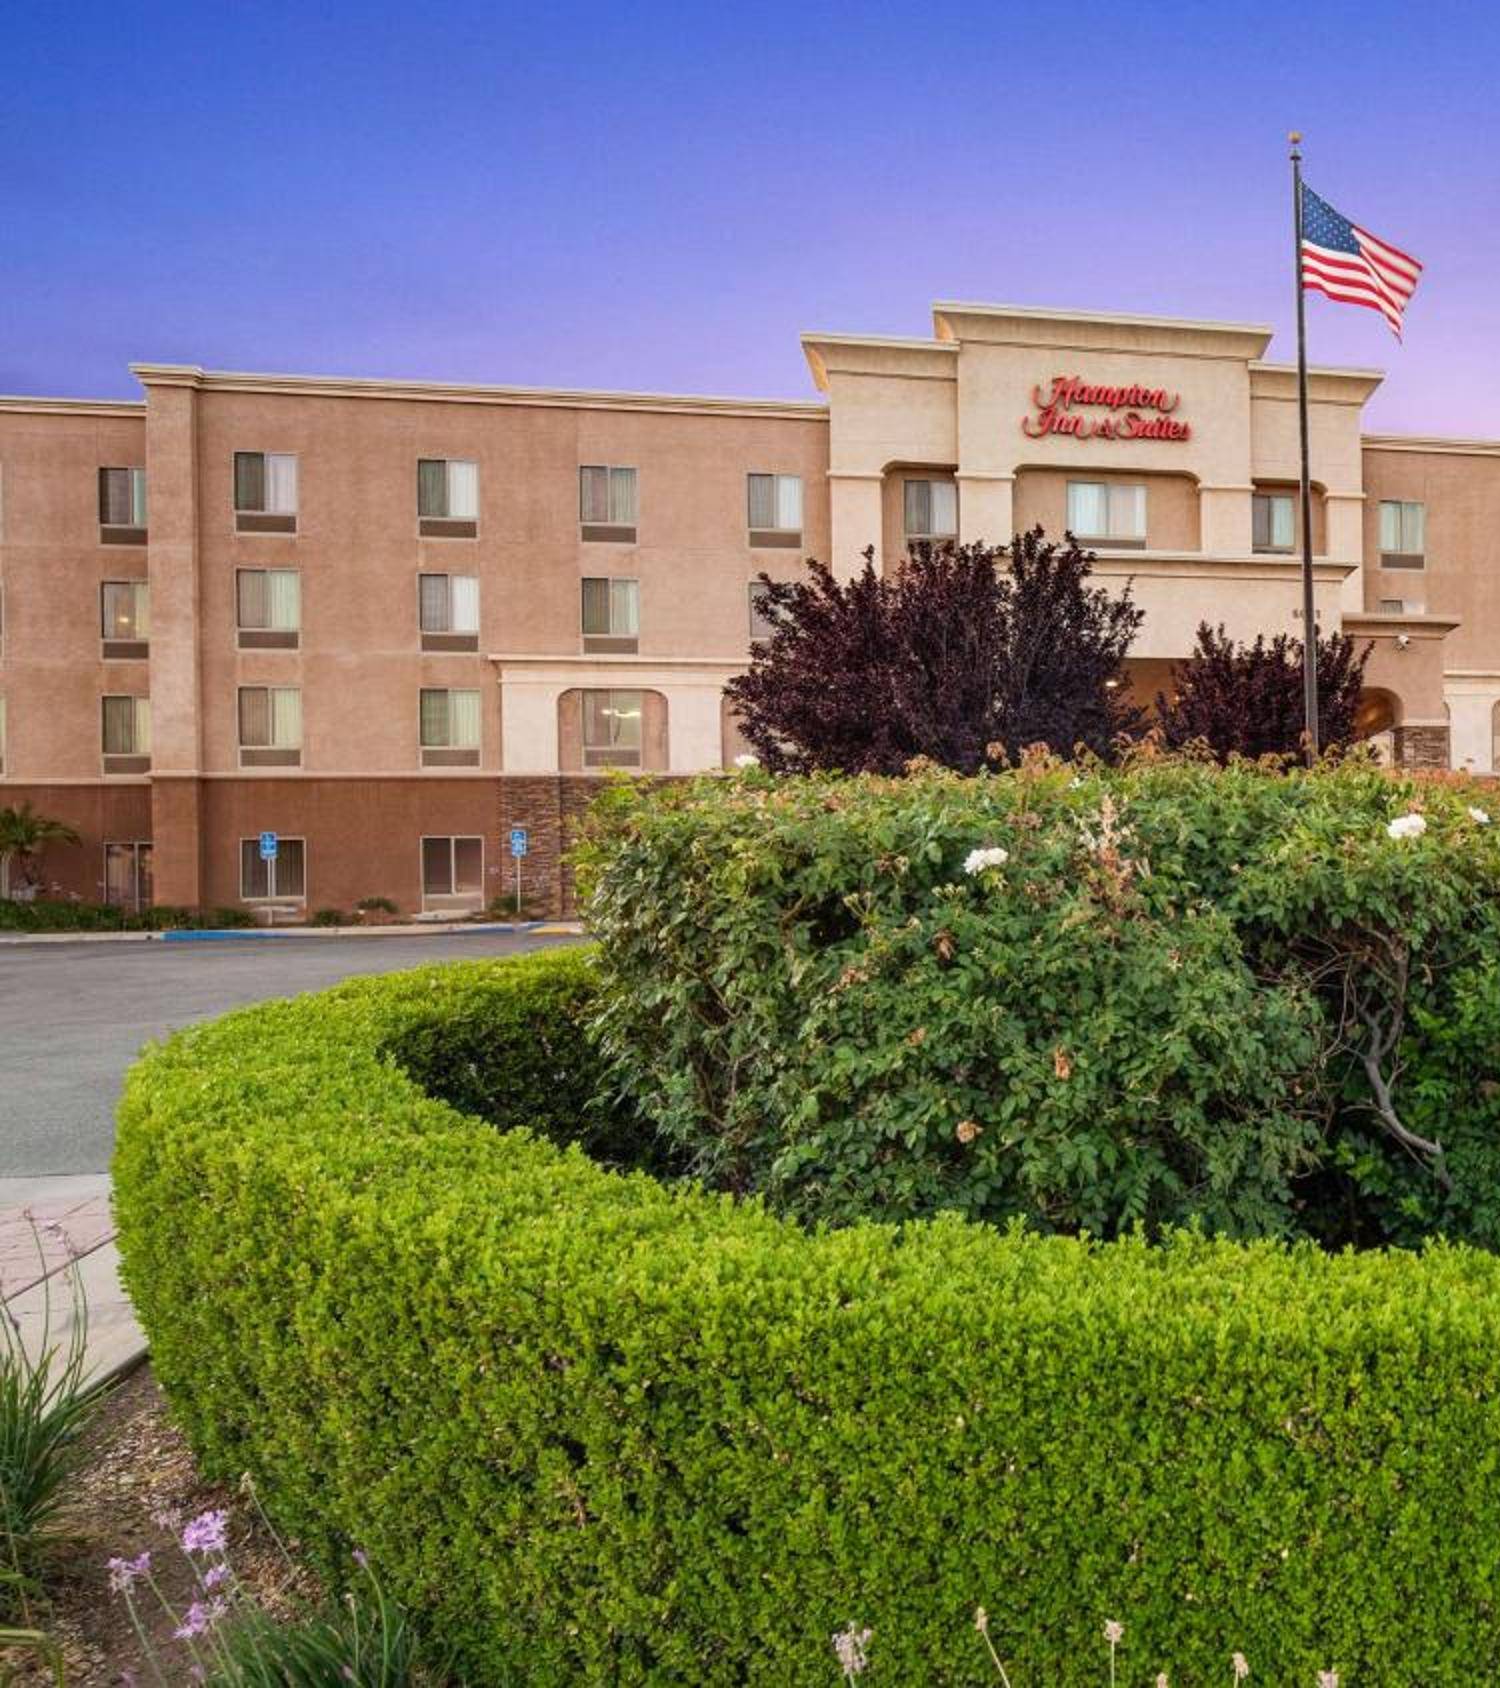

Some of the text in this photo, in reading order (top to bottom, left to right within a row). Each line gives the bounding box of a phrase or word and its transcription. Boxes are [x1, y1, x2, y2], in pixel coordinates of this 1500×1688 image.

[1032, 375, 1181, 412] Hampton
[1022, 408, 1191, 441] Inn & Suites
